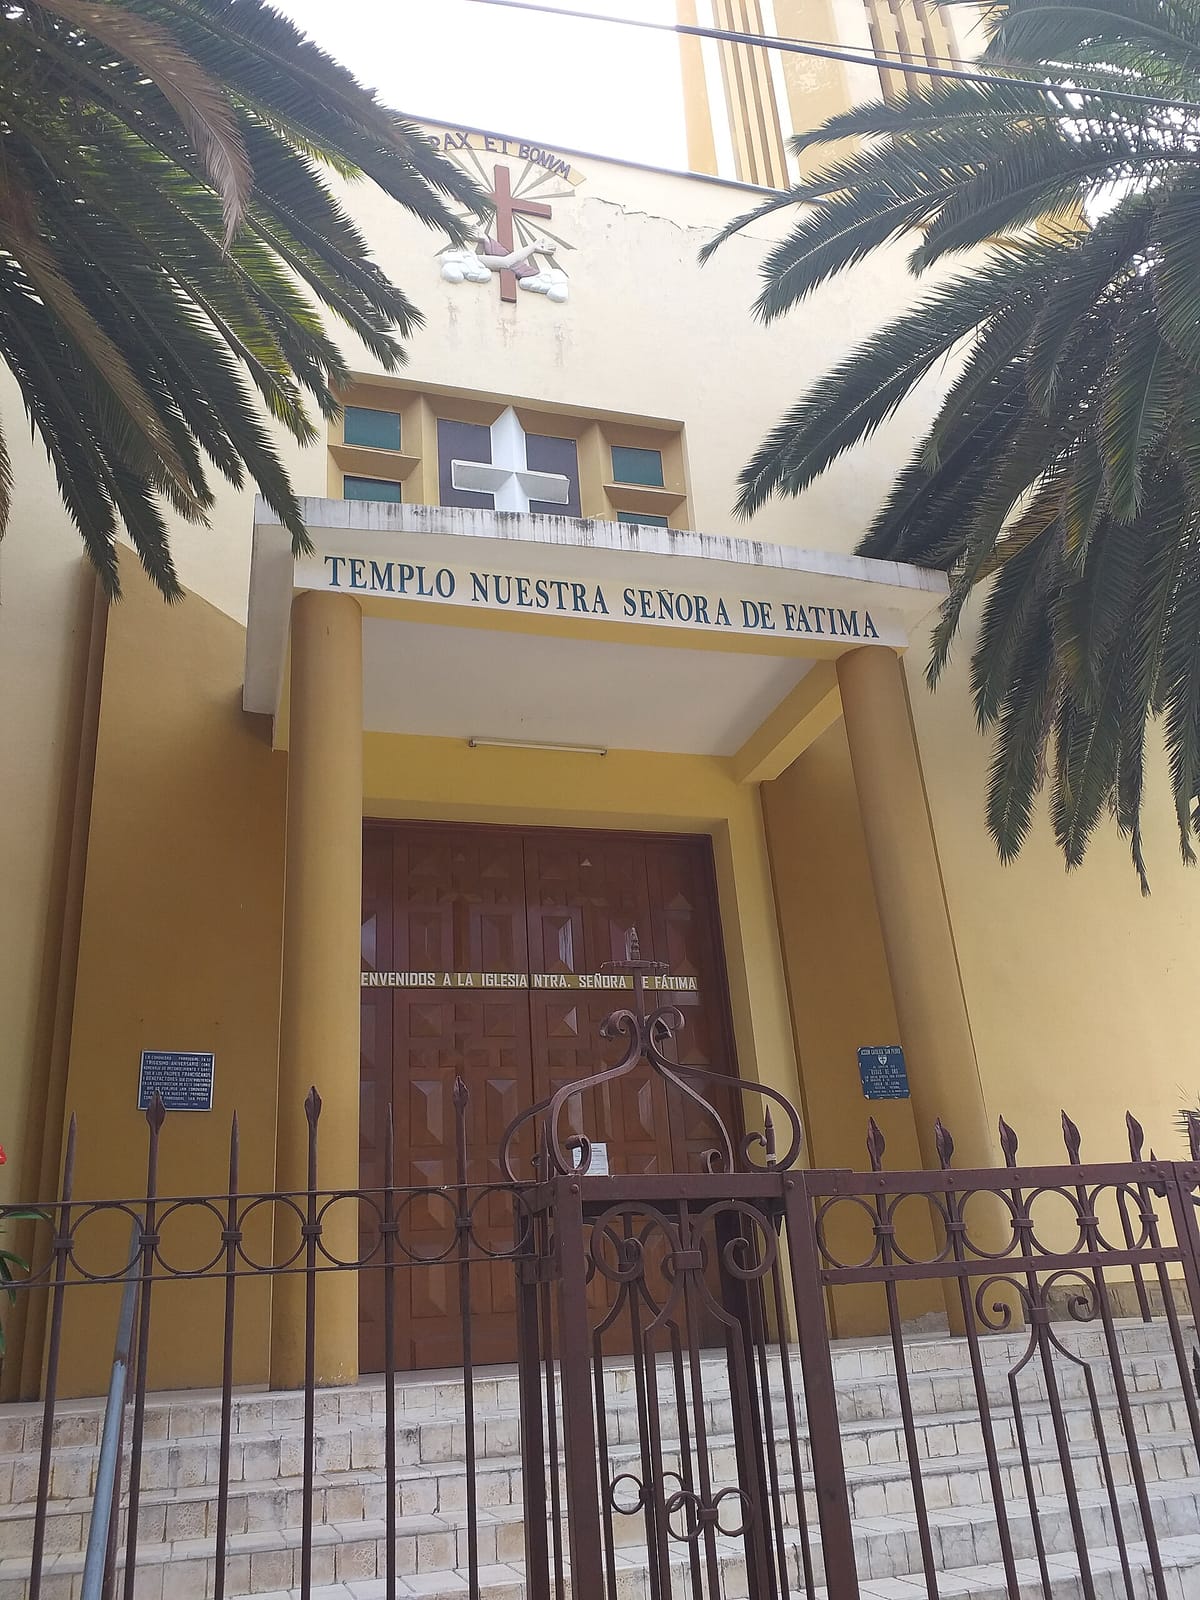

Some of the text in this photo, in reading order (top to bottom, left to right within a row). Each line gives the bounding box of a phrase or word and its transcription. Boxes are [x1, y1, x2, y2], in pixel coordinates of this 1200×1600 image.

[427, 133, 472, 151] PAX
[484, 135, 512, 154] ET
[324, 555, 880, 638] TEMPLO NUESTRA SEÑORA DE FATIMA
[443, 972, 452, 986] A
[457, 973, 474, 986] LA
[481, 973, 528, 987] IGLESIA
[533, 974, 571, 988] NTRA.
[579, 973, 627, 989] SEÑORA
[655, 974, 697, 989] FÁTIMA
